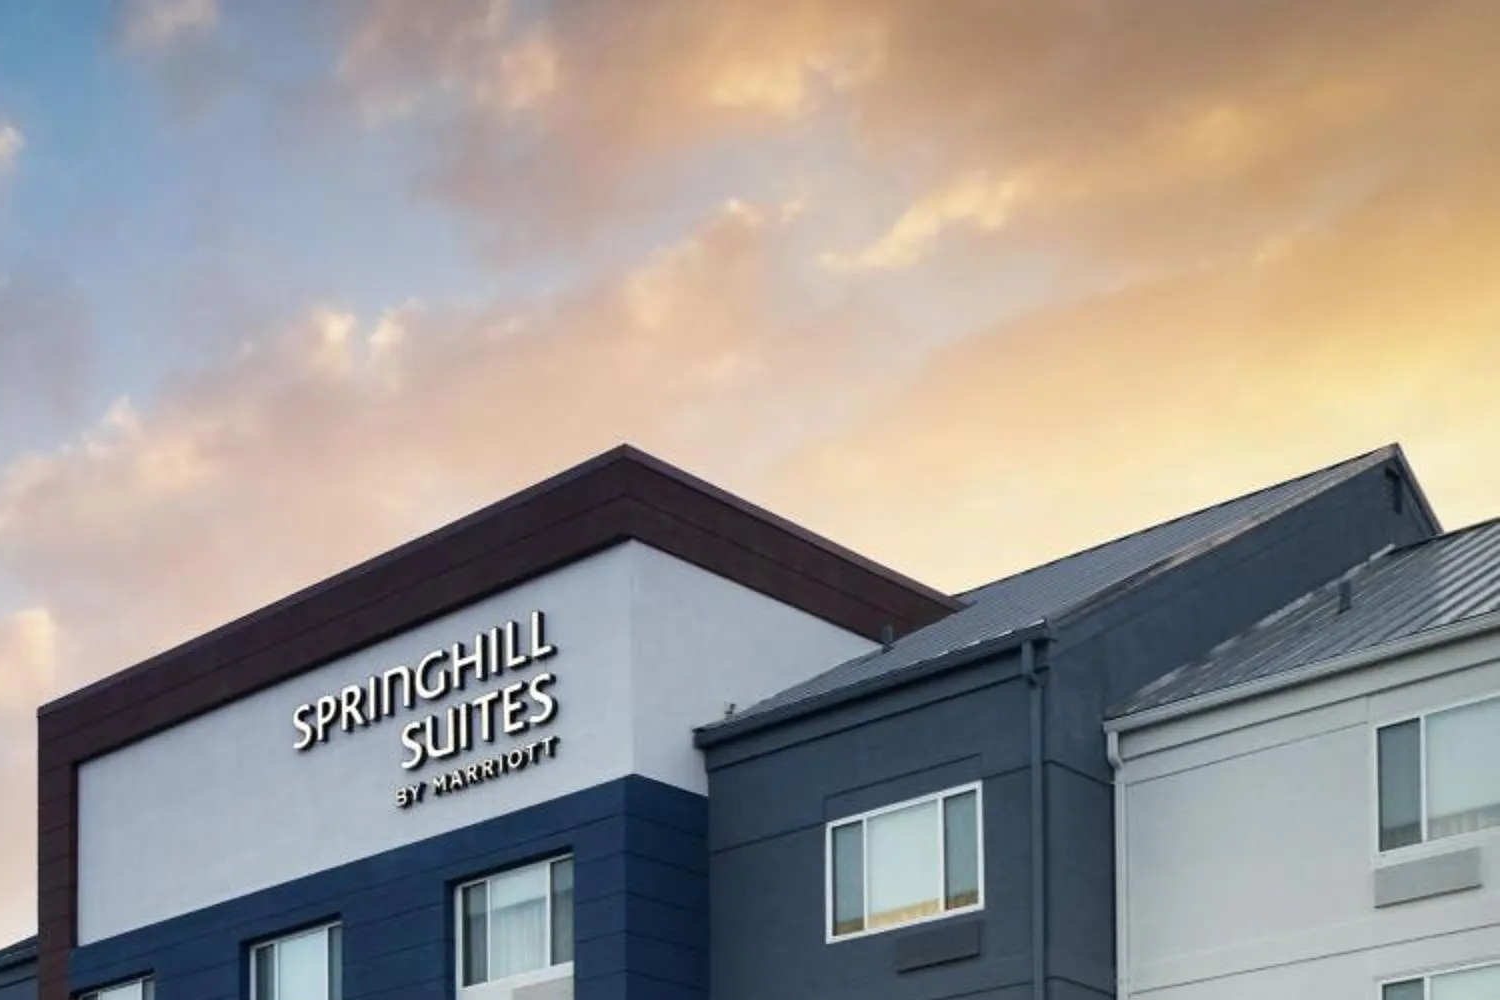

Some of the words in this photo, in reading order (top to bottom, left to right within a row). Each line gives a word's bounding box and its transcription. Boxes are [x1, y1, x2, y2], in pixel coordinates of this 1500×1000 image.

[292, 610, 557, 751] SPRINGHILL
[400, 673, 558, 770] SUITES
[396, 782, 426, 809] BY
[433, 735, 560, 796] MARRIOTT
